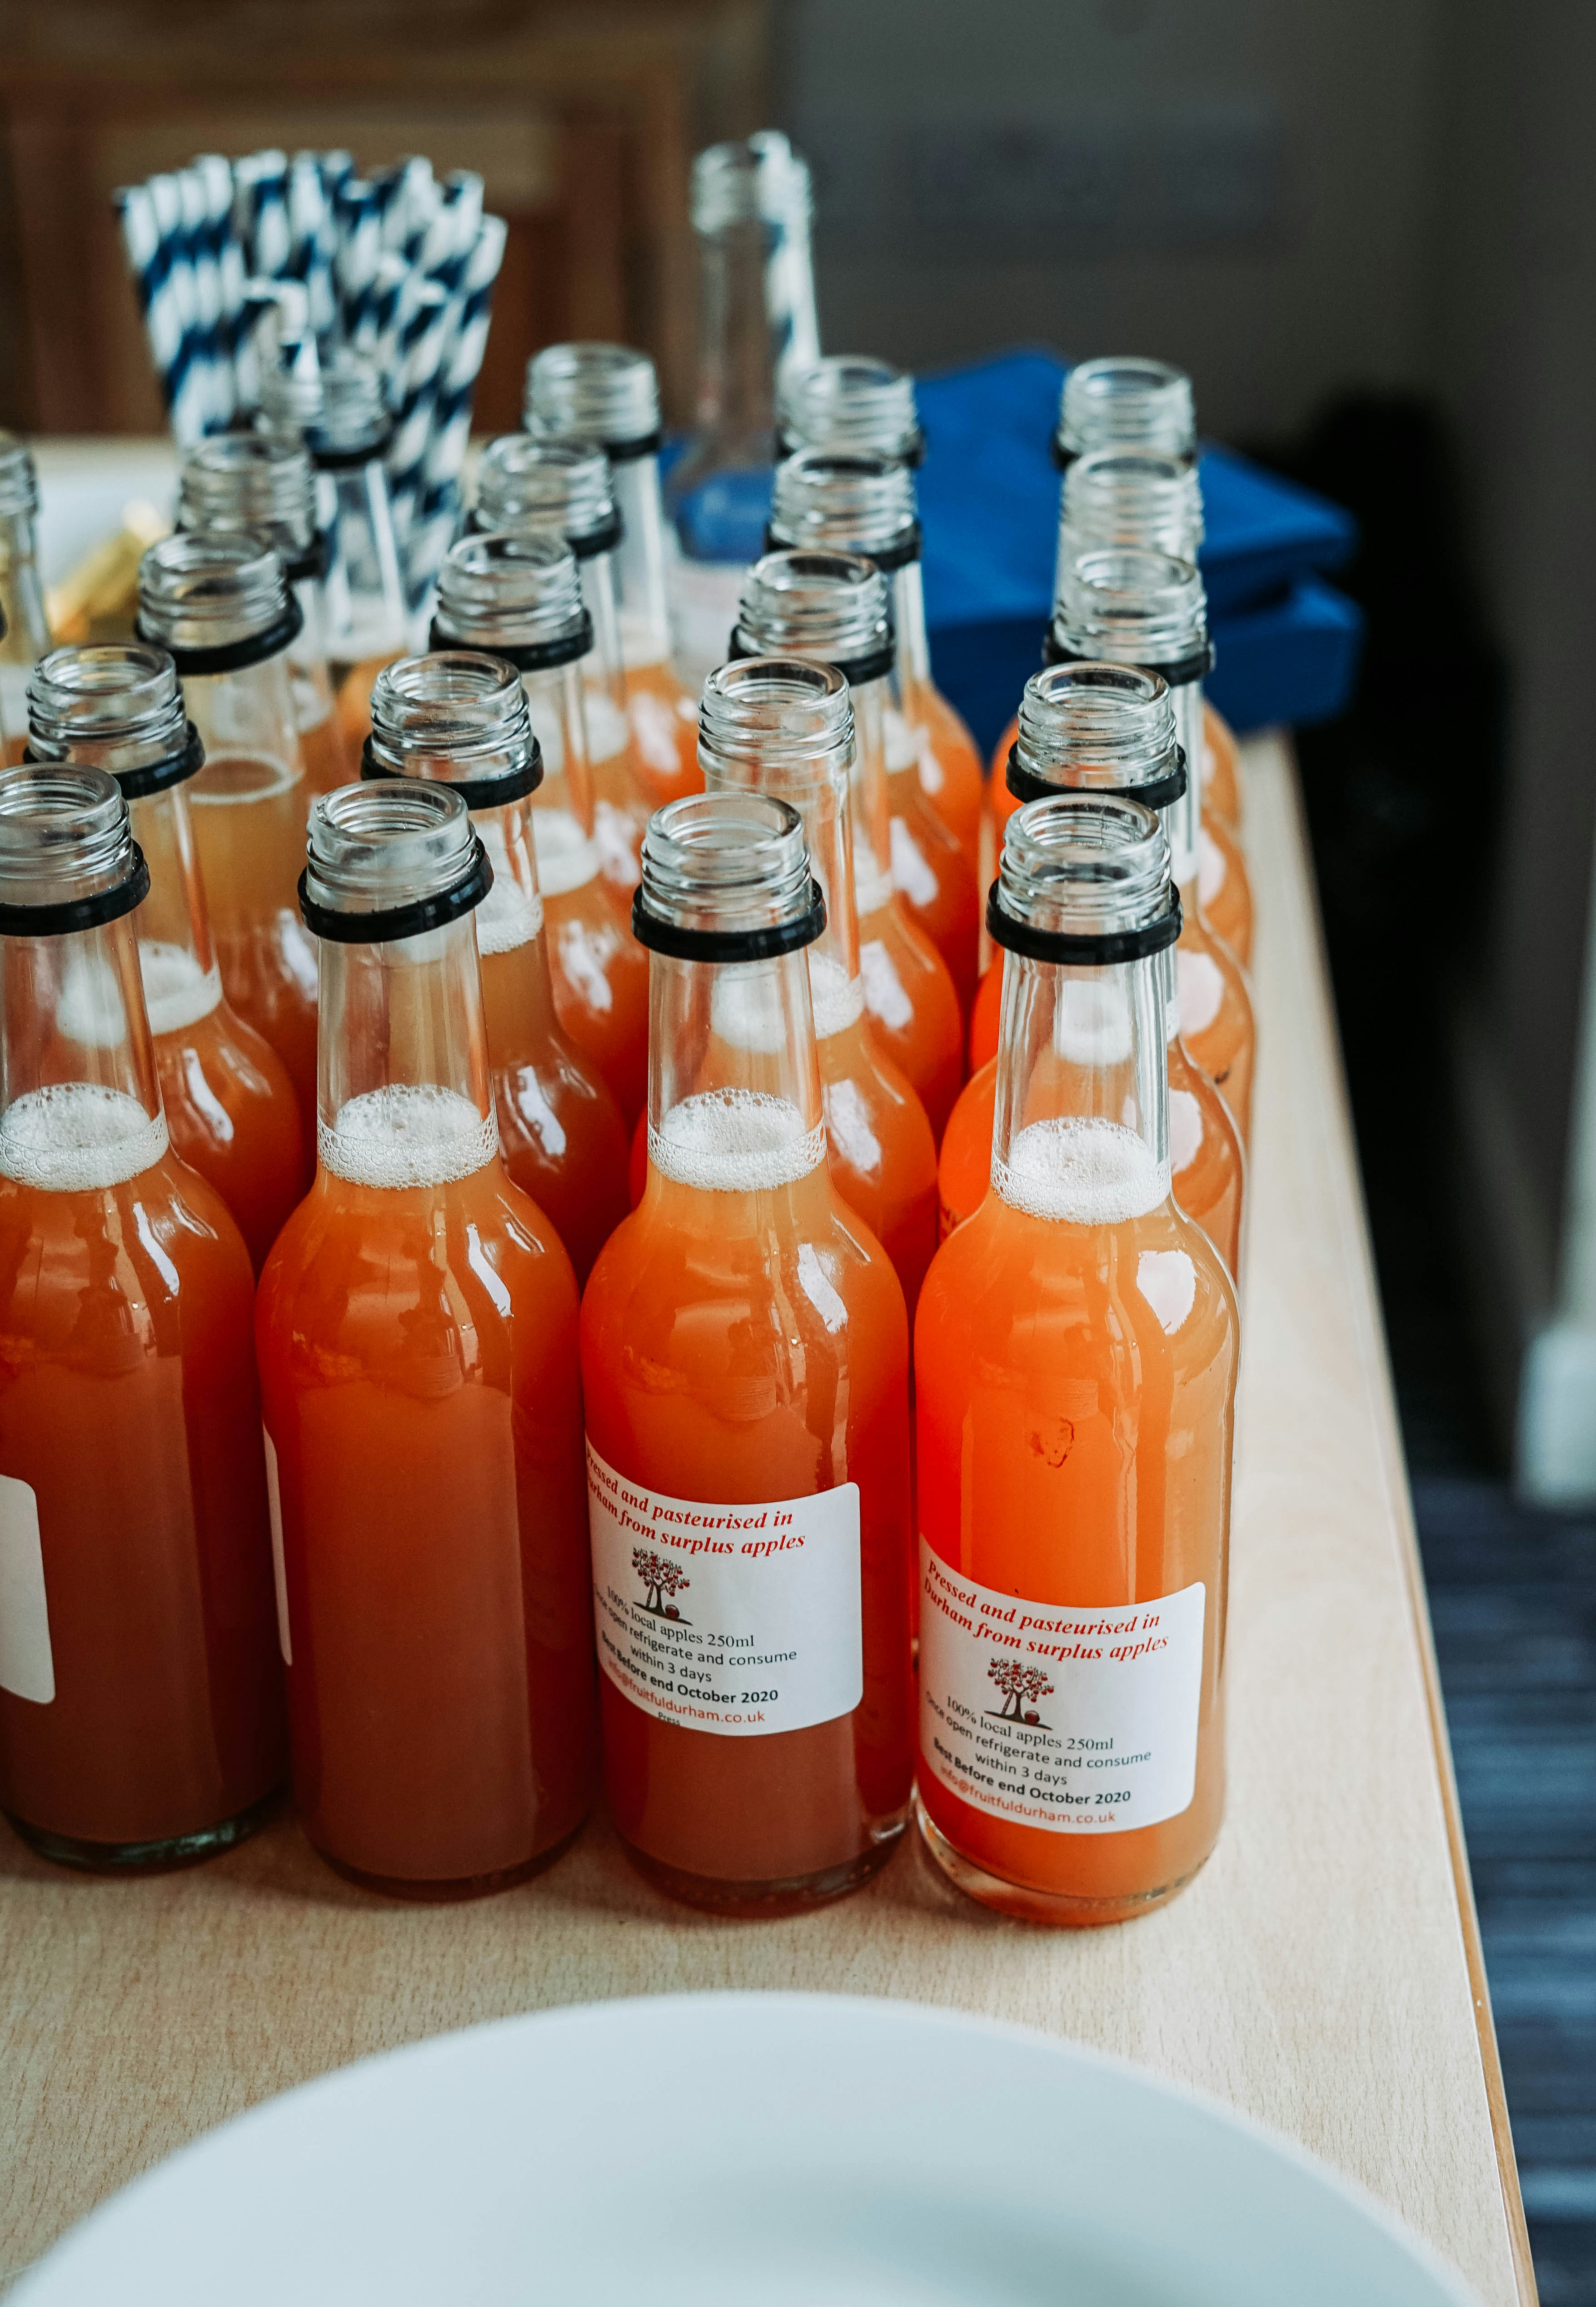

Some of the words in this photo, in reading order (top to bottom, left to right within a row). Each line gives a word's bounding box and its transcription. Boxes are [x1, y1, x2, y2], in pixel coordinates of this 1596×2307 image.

[589, 1475, 618, 1518] urham
[618, 1510, 656, 1540] from
[661, 1533, 734, 1555] surplus
[741, 1535, 805, 1557] apples
[621, 1490, 649, 1512] and
[651, 1505, 768, 1530] pasteurised
[773, 1511, 793, 1526] in
[924, 1577, 972, 1630] Durham
[973, 1622, 1021, 1649] from
[1026, 1641, 1103, 1661] surplus
[1110, 1636, 1168, 1661] apples
[929, 1559, 977, 1608] Pressed
[980, 1603, 1017, 1623] and
[1018, 1615, 1138, 1635] pasteurised
[1142, 1614, 1160, 1629] in
[629, 1627, 693, 1660] refrigerate
[698, 1653, 723, 1665] and
[729, 1651, 797, 1665] consume
[631, 1607, 656, 1631] local
[660, 1626, 703, 1644] apples
[707, 1634, 755, 1648] 250ml
[617, 1648, 647, 1680] Before
[650, 1676, 673, 1692] end
[678, 1684, 736, 1704] October
[741, 1690, 778, 1703] 2020
[630, 1644, 664, 1671] within
[668, 1662, 675, 1674] 3
[680, 1666, 712, 1683] days
[947, 1716, 972, 1739] open
[976, 1735, 1050, 1764] refrigerate
[1055, 1757, 1082, 1768] and
[1087, 1752, 1151, 1768] consume
[948, 1695, 976, 1724] 100%
[980, 1716, 1011, 1737] local
[1017, 1730, 1062, 1748] apples
[1067, 1738, 1113, 1750] 250ml
[955, 1757, 994, 1786] Before
[998, 1781, 1025, 1795] end
[1029, 1788, 1091, 1804] October
[1095, 1791, 1131, 1804] 2020
[975, 1753, 1016, 1775] within
[1022, 1766, 1029, 1778] 3
[1034, 1770, 1067, 1786] days
